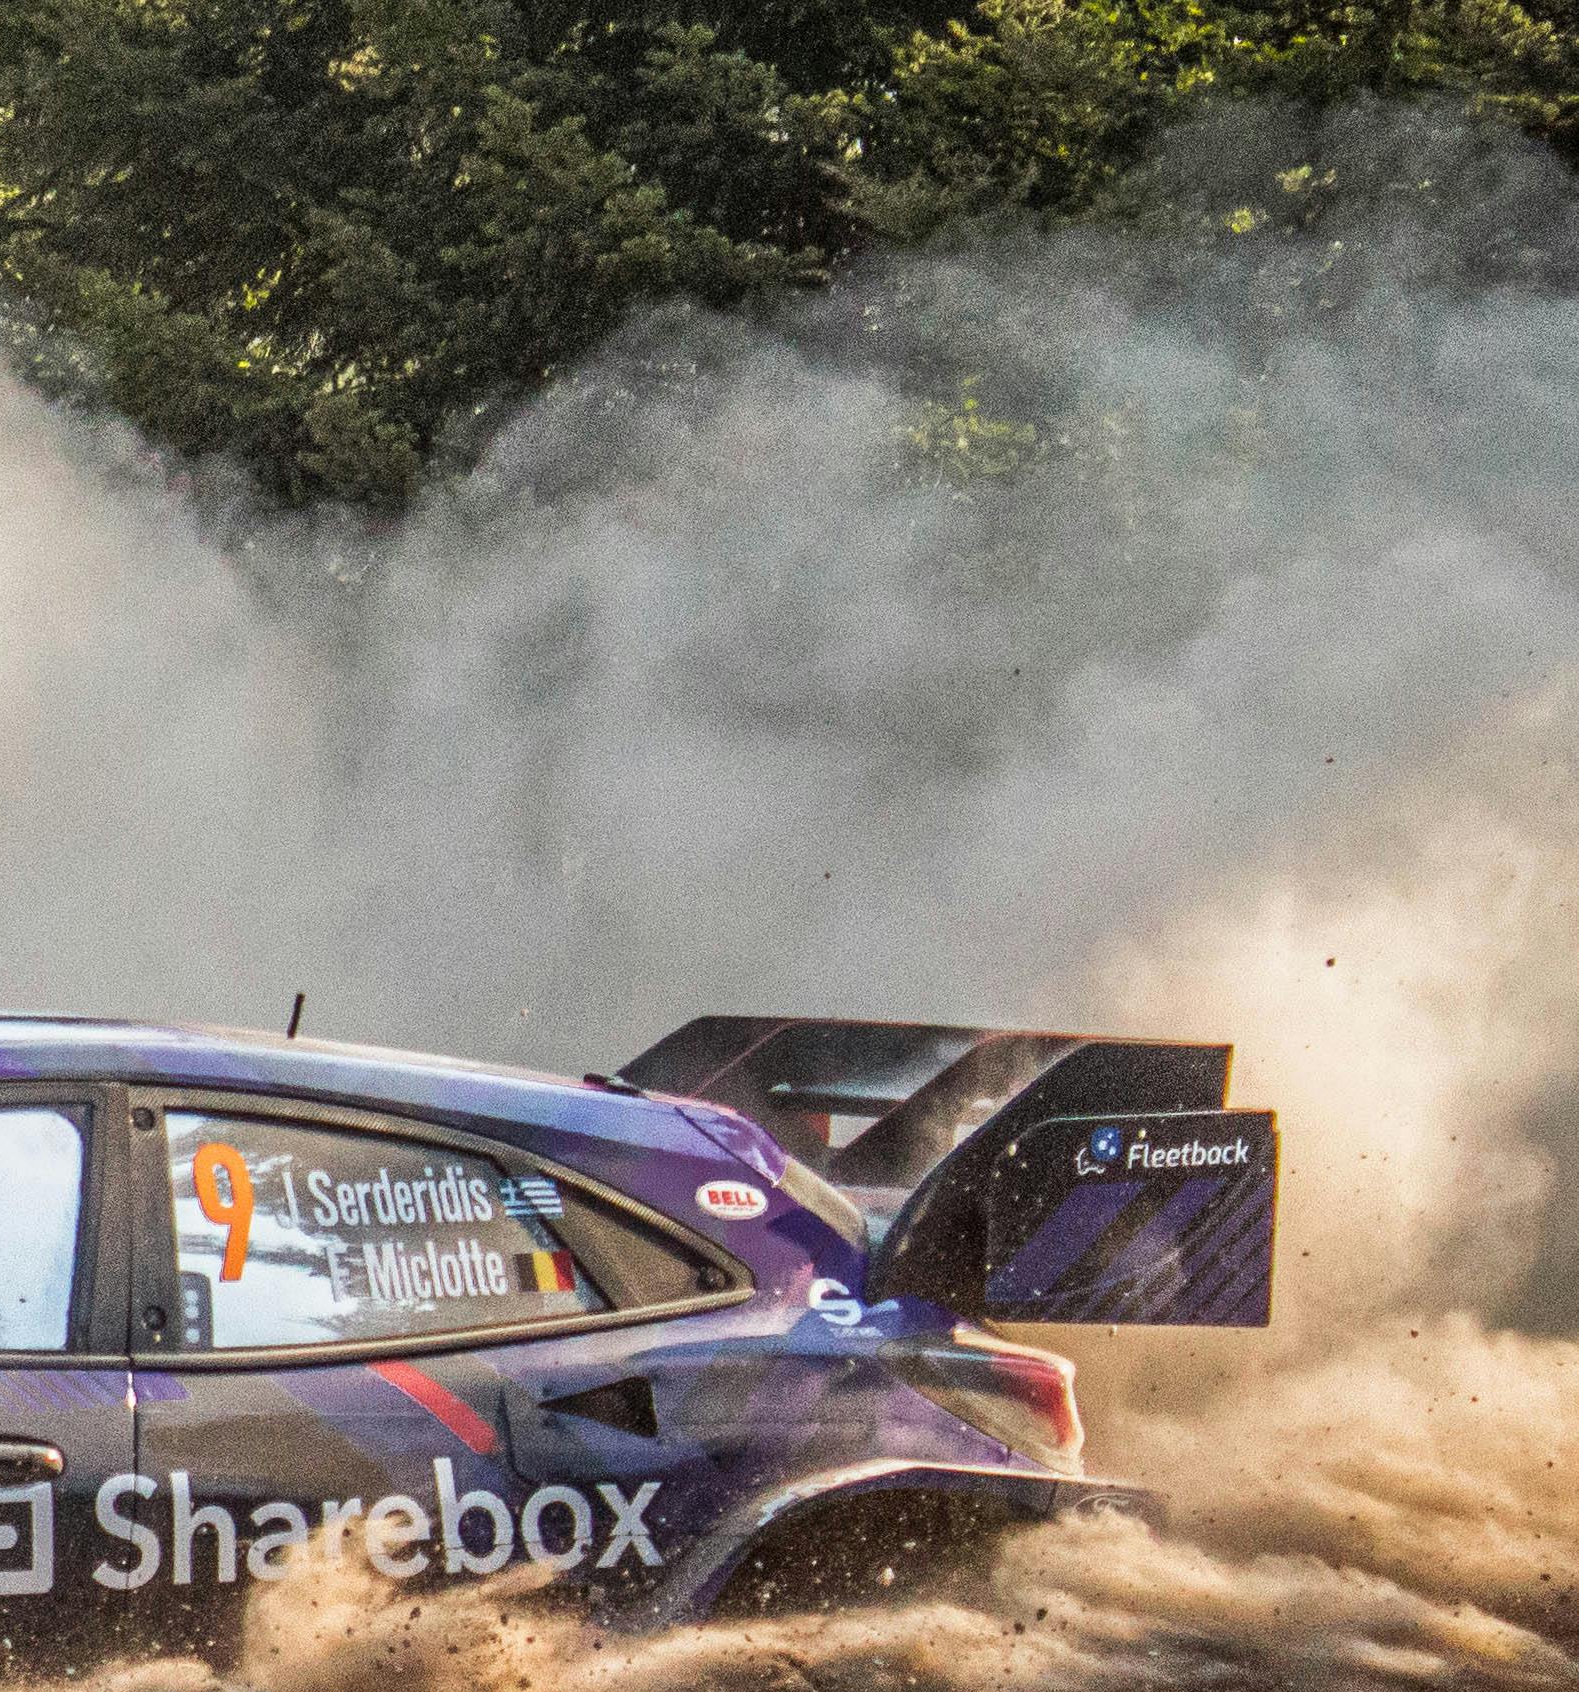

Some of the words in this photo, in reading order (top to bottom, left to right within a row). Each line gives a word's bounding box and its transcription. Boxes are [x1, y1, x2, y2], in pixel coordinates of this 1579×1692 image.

[1127, 1139, 1249, 1169] Fleetback
[193, 1142, 254, 1283] 9
[274, 1171, 300, 1229] J
[308, 1166, 493, 1228] Serderidis
[708, 1190, 758, 1206] BELL
[363, 1239, 509, 1301] Miclotte
[92, 1457, 666, 1589] Sharebox
